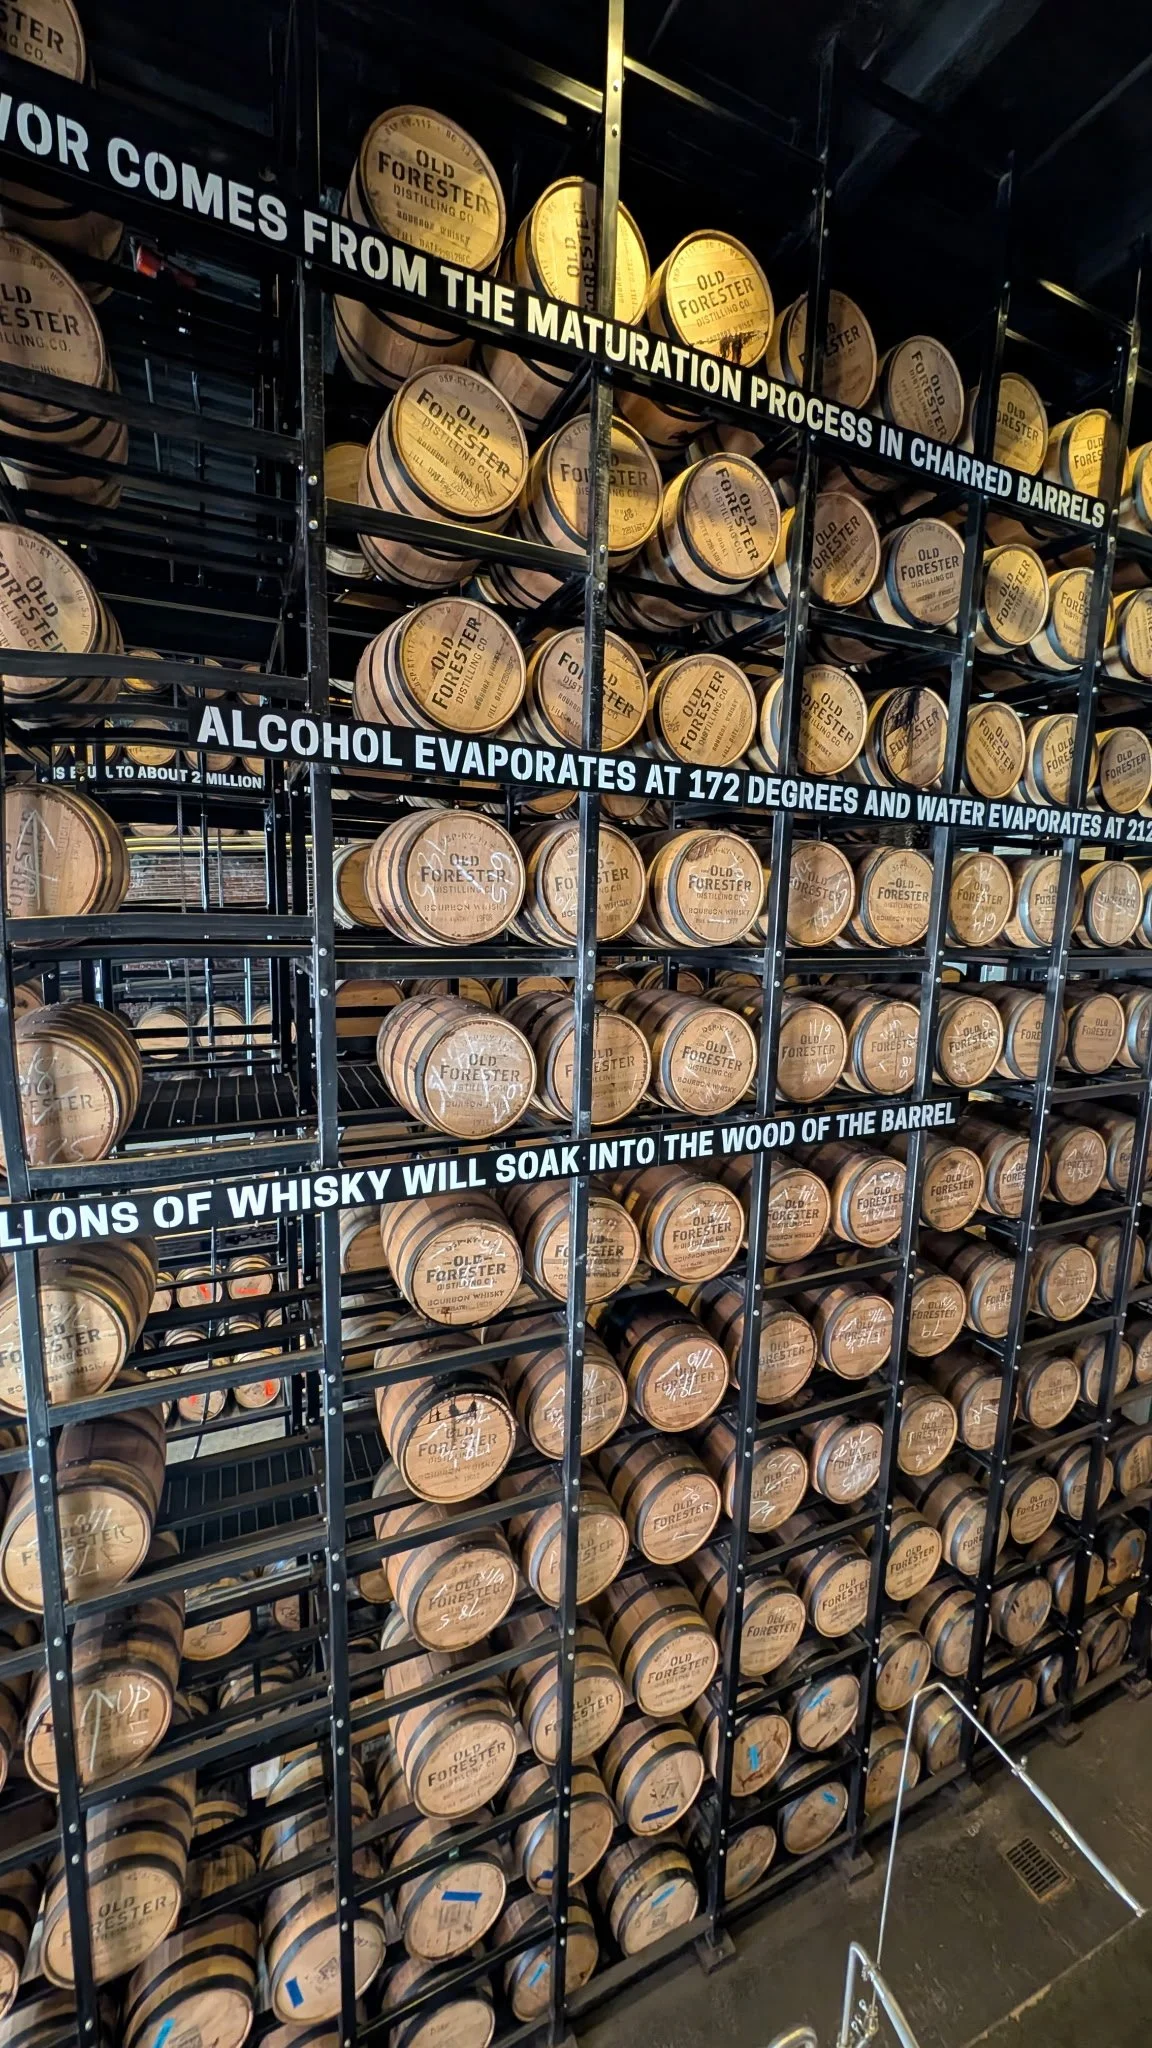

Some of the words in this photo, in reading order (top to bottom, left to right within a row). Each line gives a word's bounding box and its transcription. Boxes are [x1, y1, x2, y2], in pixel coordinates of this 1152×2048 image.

[416, 149, 455, 179] OLD
[378, 151, 492, 216] FORESTER
[393, 183, 456, 219] DISTILLING
[565, 237, 580, 278] OLD
[696, 270, 725, 291] OLD
[677, 277, 755, 319] FORESTER
[696, 305, 738, 328] DISTILLING
[107, 137, 288, 241] COMES
[304, 209, 427, 298] FROM
[440, 265, 515, 327] THE
[527, 296, 741, 402] MATURATION
[751, 375, 872, 449] PROCESS
[879, 425, 903, 461] IN
[910, 437, 1013, 498] CHARRED
[1017, 475, 1106, 529] BARRELS
[911, 350, 948, 438] FORESTER
[930, 373, 945, 407] OLD
[1007, 401, 1026, 420] OLD
[456, 404, 490, 440] OLD
[416, 388, 511, 479] FORESTER
[422, 418, 476, 465] DISTILLING
[1086, 437, 1104, 451] OLD
[715, 467, 760, 562] FORESTER
[739, 492, 758, 527] OLD
[815, 521, 838, 546] OLD
[918, 547, 940, 562] OLD
[901, 555, 960, 581] FORESTER
[910, 575, 945, 589] DISTILLING
[1000, 572, 1014, 598] OLD
[26, 575, 59, 618] OLD
[996, 559, 1030, 626] FORESTER
[431, 636, 454, 671] OLD
[432, 615, 483, 710] FORESTER
[456, 648, 483, 706] DISTILLING
[680, 670, 726, 752] FORESTER
[682, 687, 703, 719] OLD
[820, 692, 844, 716] OLD
[699, 699, 724, 748] DISTILLING
[979, 718, 1016, 774] FORESTER
[995, 726, 1009, 749] OLD
[1057, 736, 1074, 753] OLD
[1116, 750, 1133, 764] OLD
[197, 705, 402, 768] ALCOHOL
[415, 735, 636, 791] EVAPORATES
[645, 763, 682, 795] AT
[689, 769, 740, 802] 172
[748, 775, 859, 814] DEGREES
[864, 790, 911, 819] AND
[917, 794, 984, 827] WATER
[988, 803, 1102, 837] EVAPORATES
[1104, 816, 1125, 840] AT
[1128, 819, 1152, 842] 212
[1105, 753, 1147, 782] FORESTER
[53, 767, 65, 779] IS
[70, 767, 113, 780] EUL
[116, 766, 133, 779] TO
[137, 766, 188, 783] ABOUT
[191, 770, 201, 784] 2
[206, 772, 262, 789] MILLION
[450, 853, 480, 867] OLD
[420, 866, 507, 883] FORESTER
[710, 864, 733, 878] OLD
[807, 872, 828, 885] OLD
[433, 884, 478, 894] DISTILLING
[688, 875, 752, 891] FORESTER
[789, 876, 842, 902] FORESTER
[896, 877, 914, 889] OLD
[973, 880, 990, 892] OLD
[877, 886, 929, 902] FORESTER
[957, 889, 1003, 906] FORESTER
[424, 904, 470, 912] BOURBON
[1082, 1025, 1117, 1037] FORESTER
[1095, 1018, 1108, 1027] OLD
[800, 1034, 819, 1044] OLD
[949, 1029, 994, 1051] FORESTER
[963, 1027, 980, 1037] OLD
[705, 1040, 727, 1054] OLD
[782, 1045, 836, 1059] FORESTER
[469, 1053, 497, 1067] OLD
[682, 1046, 743, 1071] FORESTER
[440, 1065, 520, 1082] FORESTER
[688, 1064, 723, 1076] DISTILLING
[0, 1201, 139, 1248] LLONS
[153, 1191, 213, 1229] OF
[227, 1168, 392, 1219] WHISKY
[402, 1158, 486, 1197] WILL
[496, 1145, 581, 1183] SOAK
[589, 1137, 655, 1171] INTO
[663, 1130, 713, 1160] THE
[721, 1116, 795, 1152] WOOD
[802, 1116, 832, 1144] OF
[837, 1110, 876, 1139] THE
[881, 1101, 956, 1131] BARREL
[946, 1173, 962, 1184] OLD
[873, 1186, 891, 1196] OLD
[931, 1180, 974, 1196] FORESTER
[784, 1199, 805, 1210] OLD
[692, 1214, 714, 1226] OLD
[768, 1208, 820, 1222] FORESTER
[672, 1223, 732, 1242] FORESTER
[453, 1254, 481, 1267] OLD
[426, 1263, 507, 1283] FORESTER
[427, 1295, 470, 1306] BOURBON
[473, 1290, 505, 1300] WHISKY
[928, 1301, 944, 1310] OLD
[912, 1308, 956, 1320] FORESTER
[770, 1341, 789, 1352] OLD
[446, 1426, 473, 1438] OLD
[906, 1428, 948, 1441] FORESTER
[921, 1422, 937, 1431] OLD
[418, 1433, 497, 1457] FORESTER
[764, 1471, 782, 1485] OLD
[672, 1499, 693, 1513] OLD
[1016, 1497, 1054, 1518] FORESTER
[1029, 1495, 1044, 1504] OLD
[653, 1502, 710, 1530] FORESTER
[890, 1545, 935, 1573] FORESTER
[905, 1544, 922, 1558] OLD
[455, 1580, 480, 1592] OLD
[838, 1577, 857, 1593] OLD
[767, 1614, 786, 1625] OLD
[747, 1622, 797, 1637] FORESTER
[670, 1652, 693, 1667] OLD
[647, 1655, 710, 1685] FORESTER
[453, 1743, 482, 1762] OLD
[428, 1740, 507, 1788] FORESTER
[100, 1896, 137, 1914] OLD
